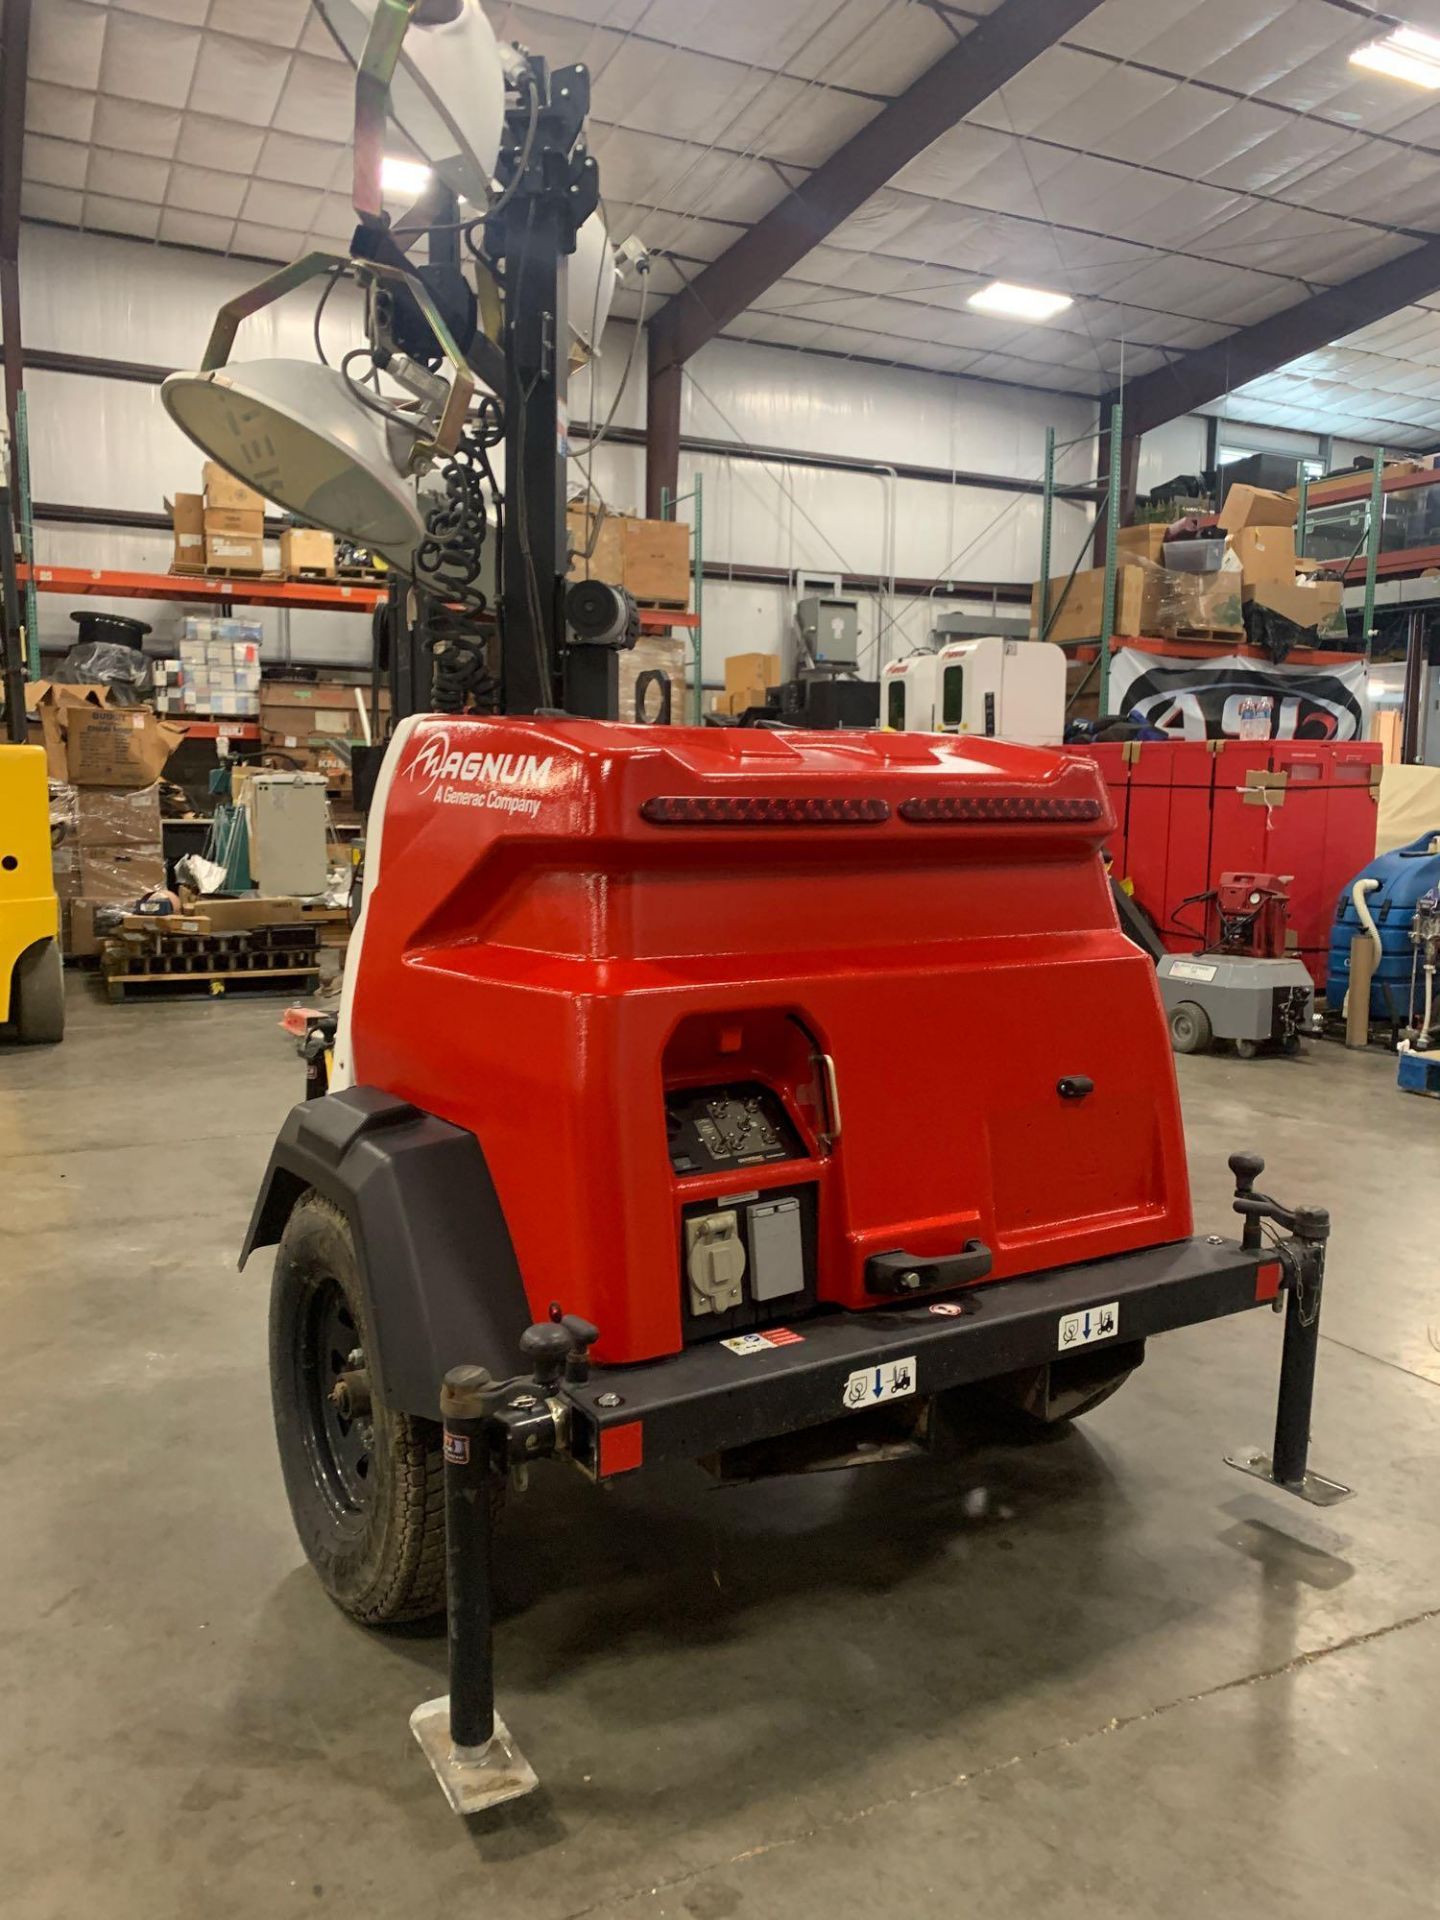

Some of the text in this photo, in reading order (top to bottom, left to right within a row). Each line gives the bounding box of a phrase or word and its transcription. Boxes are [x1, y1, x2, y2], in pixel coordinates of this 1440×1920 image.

[402, 732, 553, 795] MAGNUM
[433, 786, 541, 819] A Generac Company
